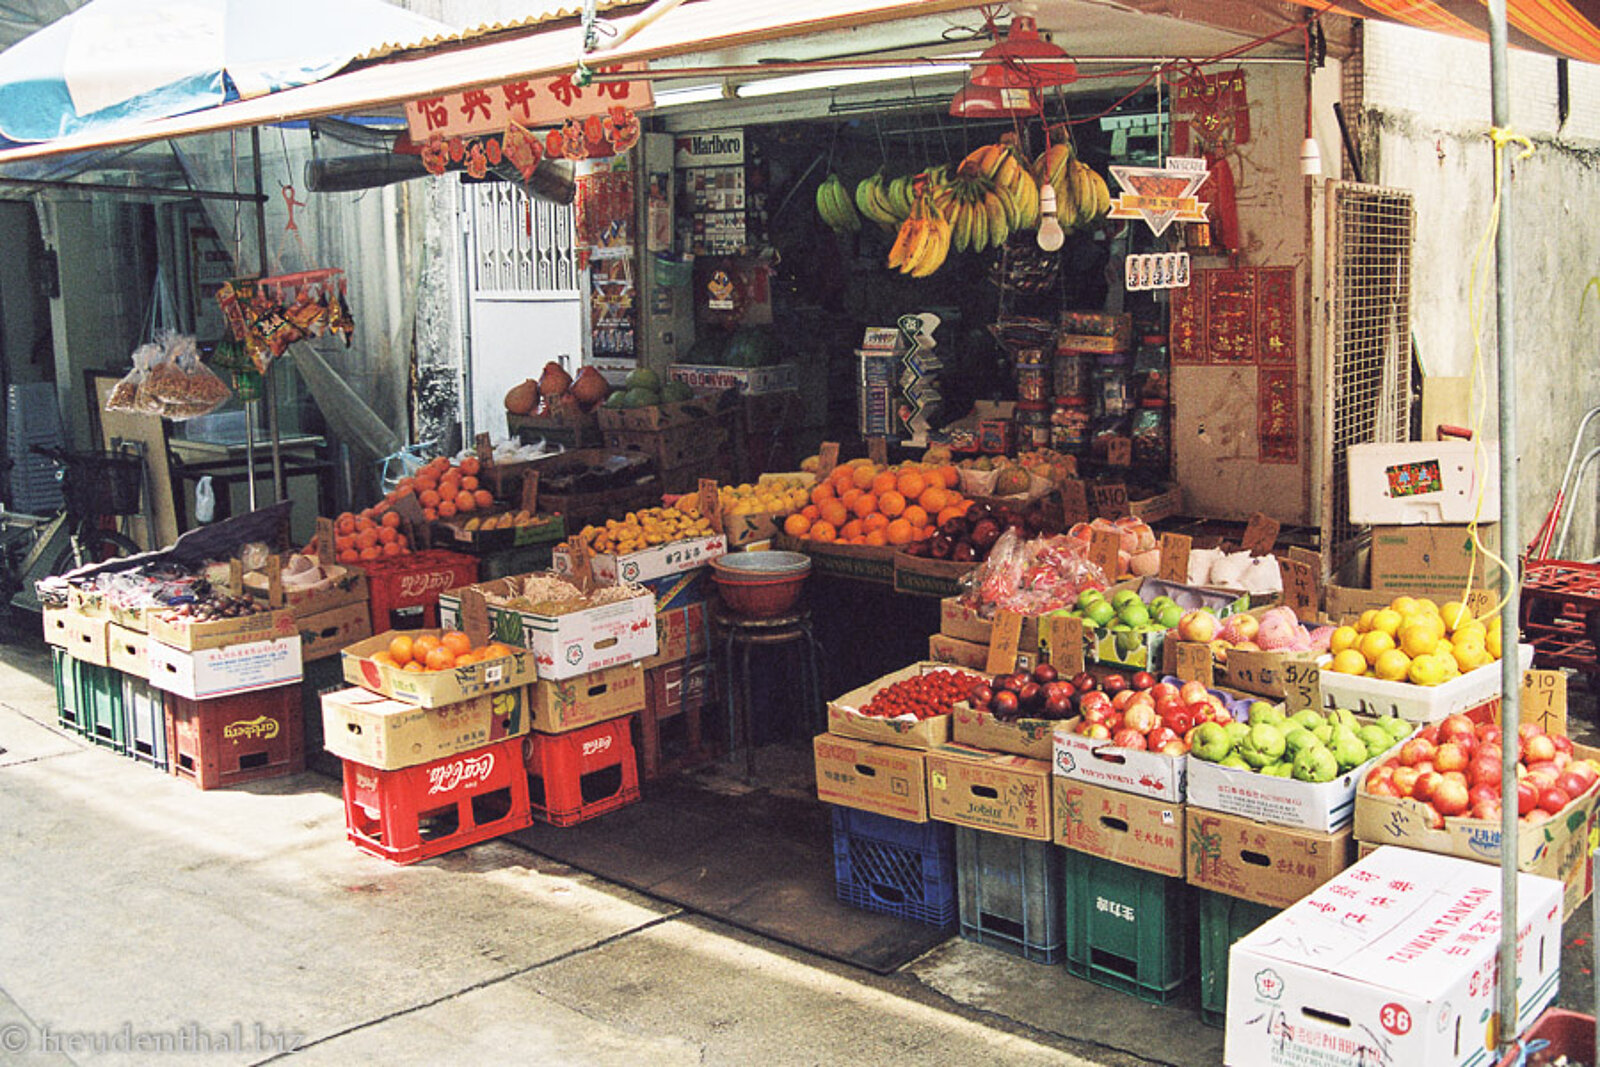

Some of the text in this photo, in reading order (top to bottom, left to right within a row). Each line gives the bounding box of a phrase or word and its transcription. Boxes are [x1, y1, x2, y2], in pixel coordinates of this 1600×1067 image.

[692, 135, 742, 156] Marlboro
[1524, 675, 1555, 689] $10
[1540, 690, 1554, 707] 7
[223, 715, 280, 741] Carlsberg
[428, 752, 496, 794] Coca-Cola
[1387, 919, 1442, 963] TAIWAN
[1434, 886, 1493, 928] TANKAN
[1382, 1006, 1409, 1030] 36
